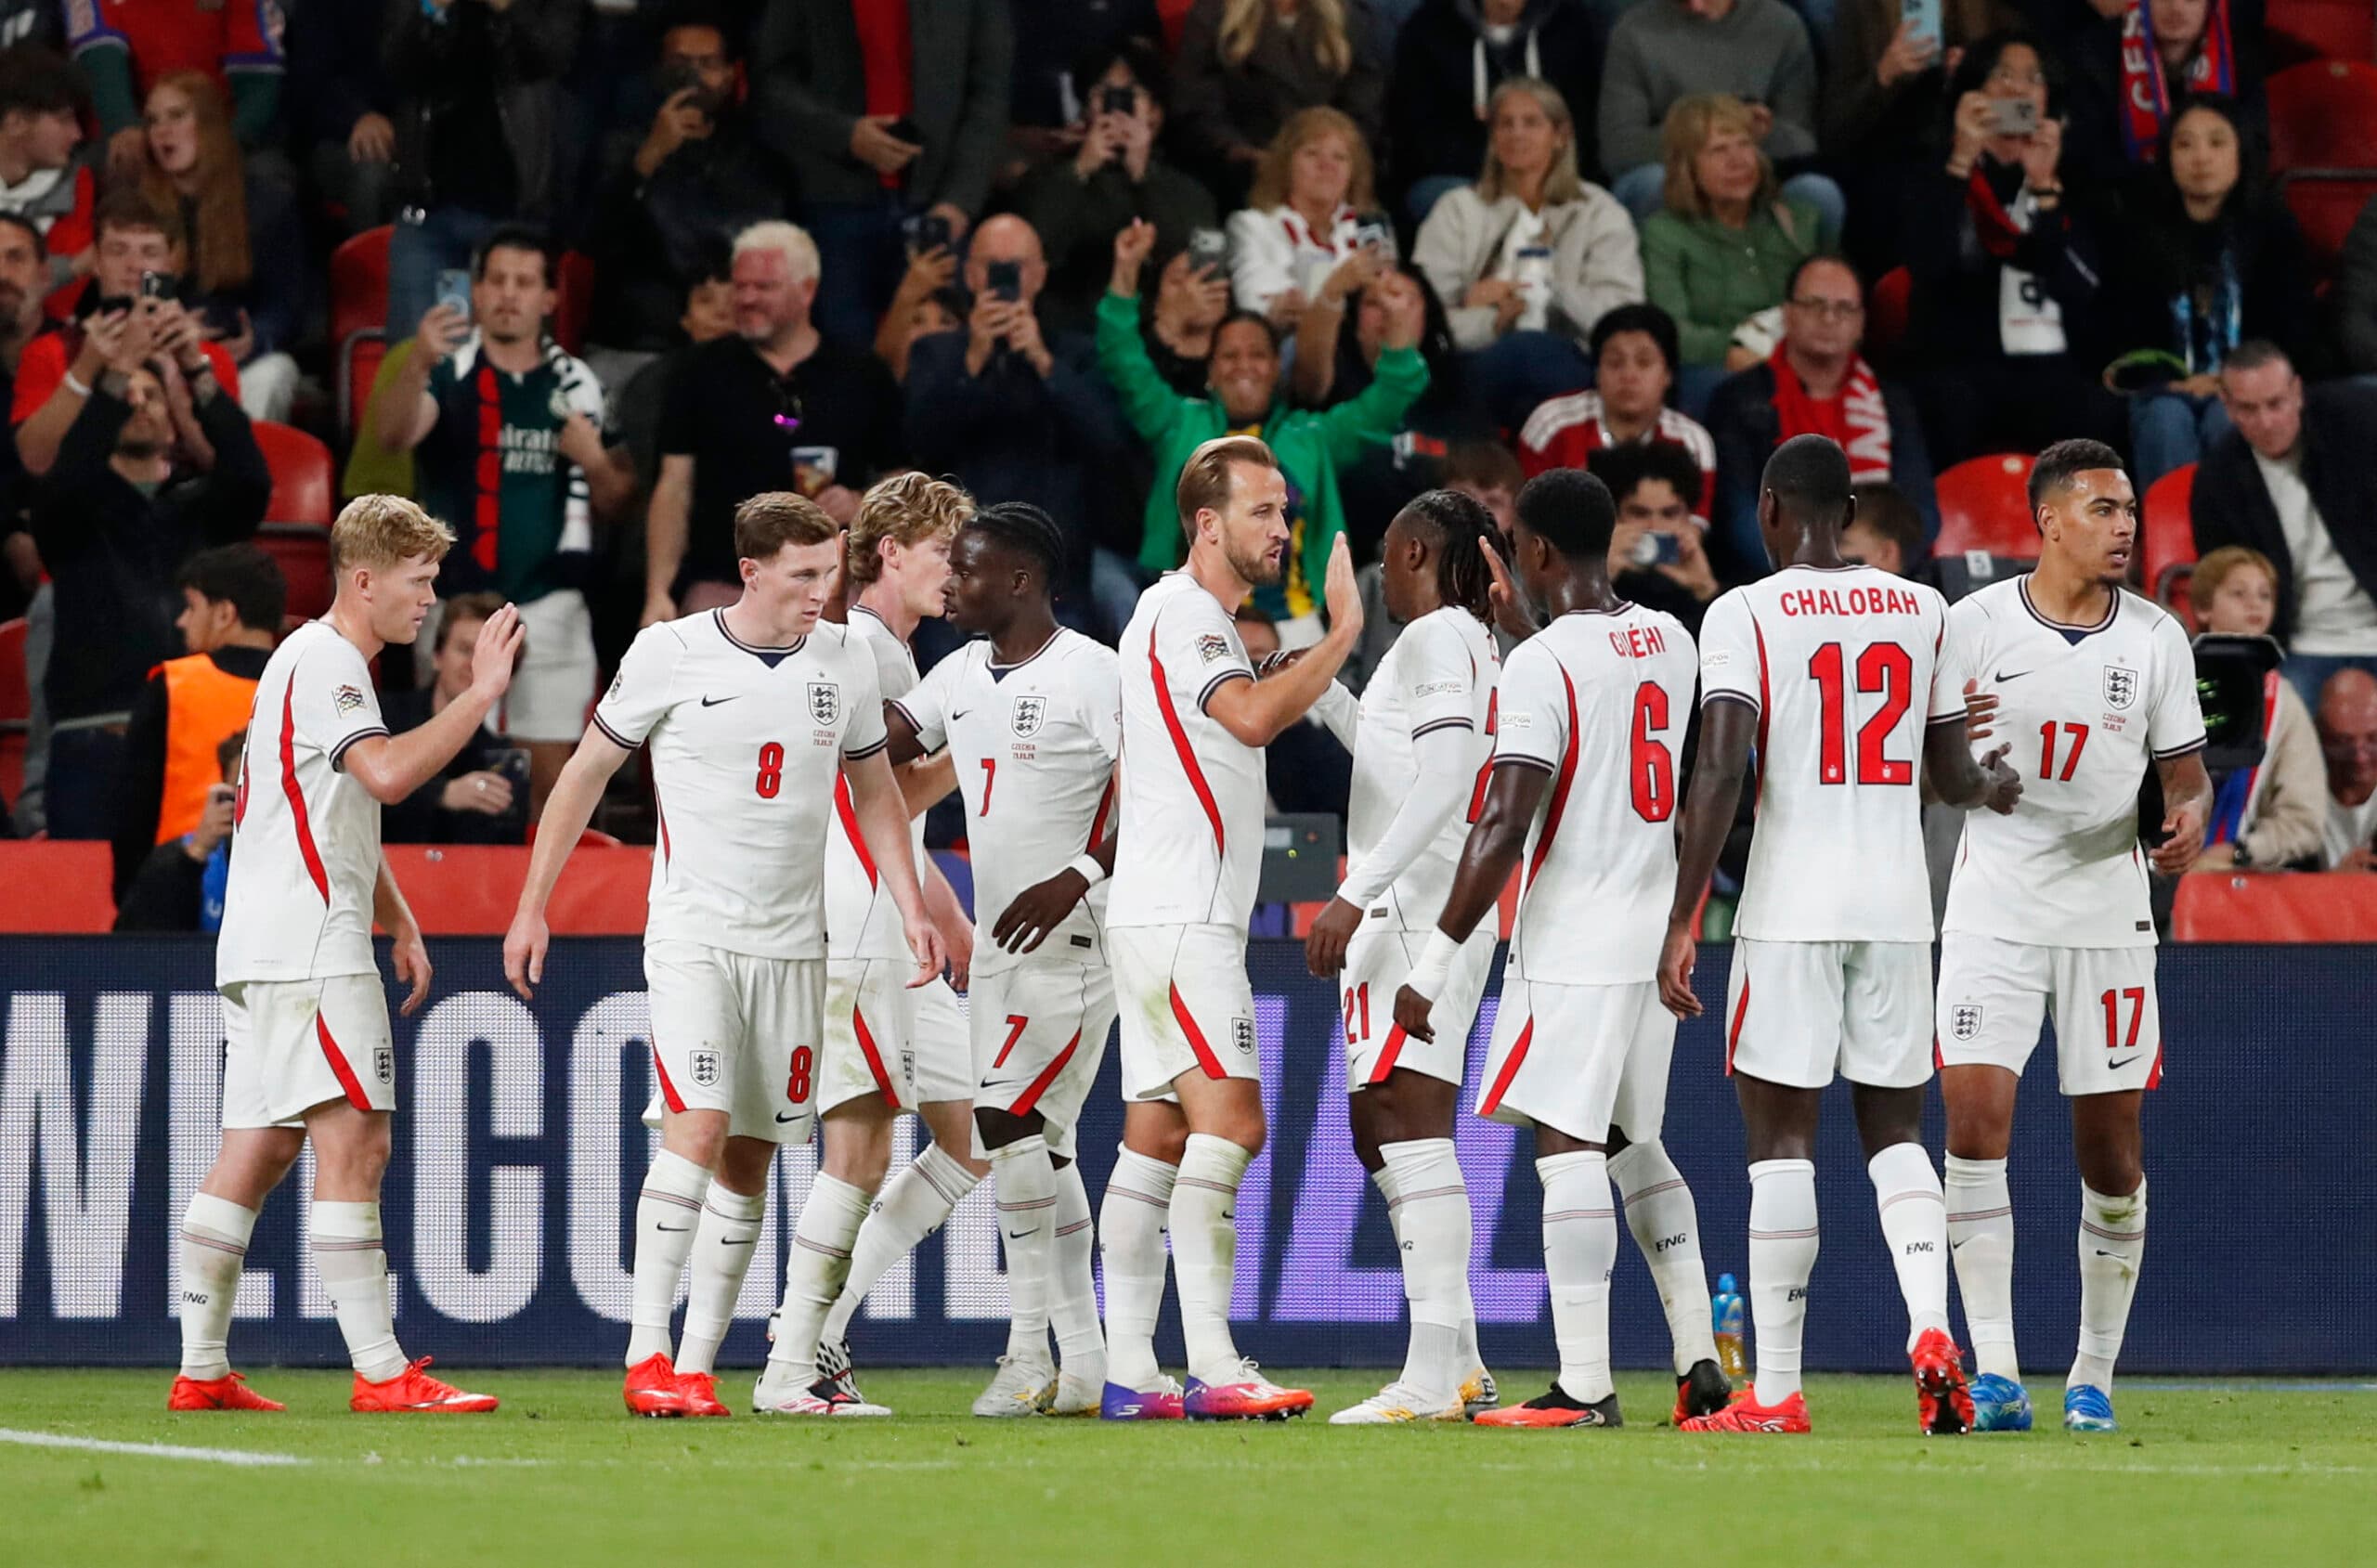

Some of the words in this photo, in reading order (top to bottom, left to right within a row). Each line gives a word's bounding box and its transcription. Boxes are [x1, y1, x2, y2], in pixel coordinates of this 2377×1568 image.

[1780, 587, 1920, 617] CHALOBAH
[1609, 623, 1666, 658] GUÉHI
[1809, 641, 1913, 785] 12
[757, 742, 782, 798] 8
[1630, 680, 1674, 823] 6
[2040, 720, 2088, 782] 17
[980, 758, 996, 817] 7
[993, 1015, 1028, 1069] 7
[1344, 981, 1369, 1044] 21
[2100, 987, 2145, 1048] 17
[787, 1045, 812, 1105] 8
[1656, 1232, 1686, 1252] ENG
[1906, 1241, 1934, 1254] ENG
